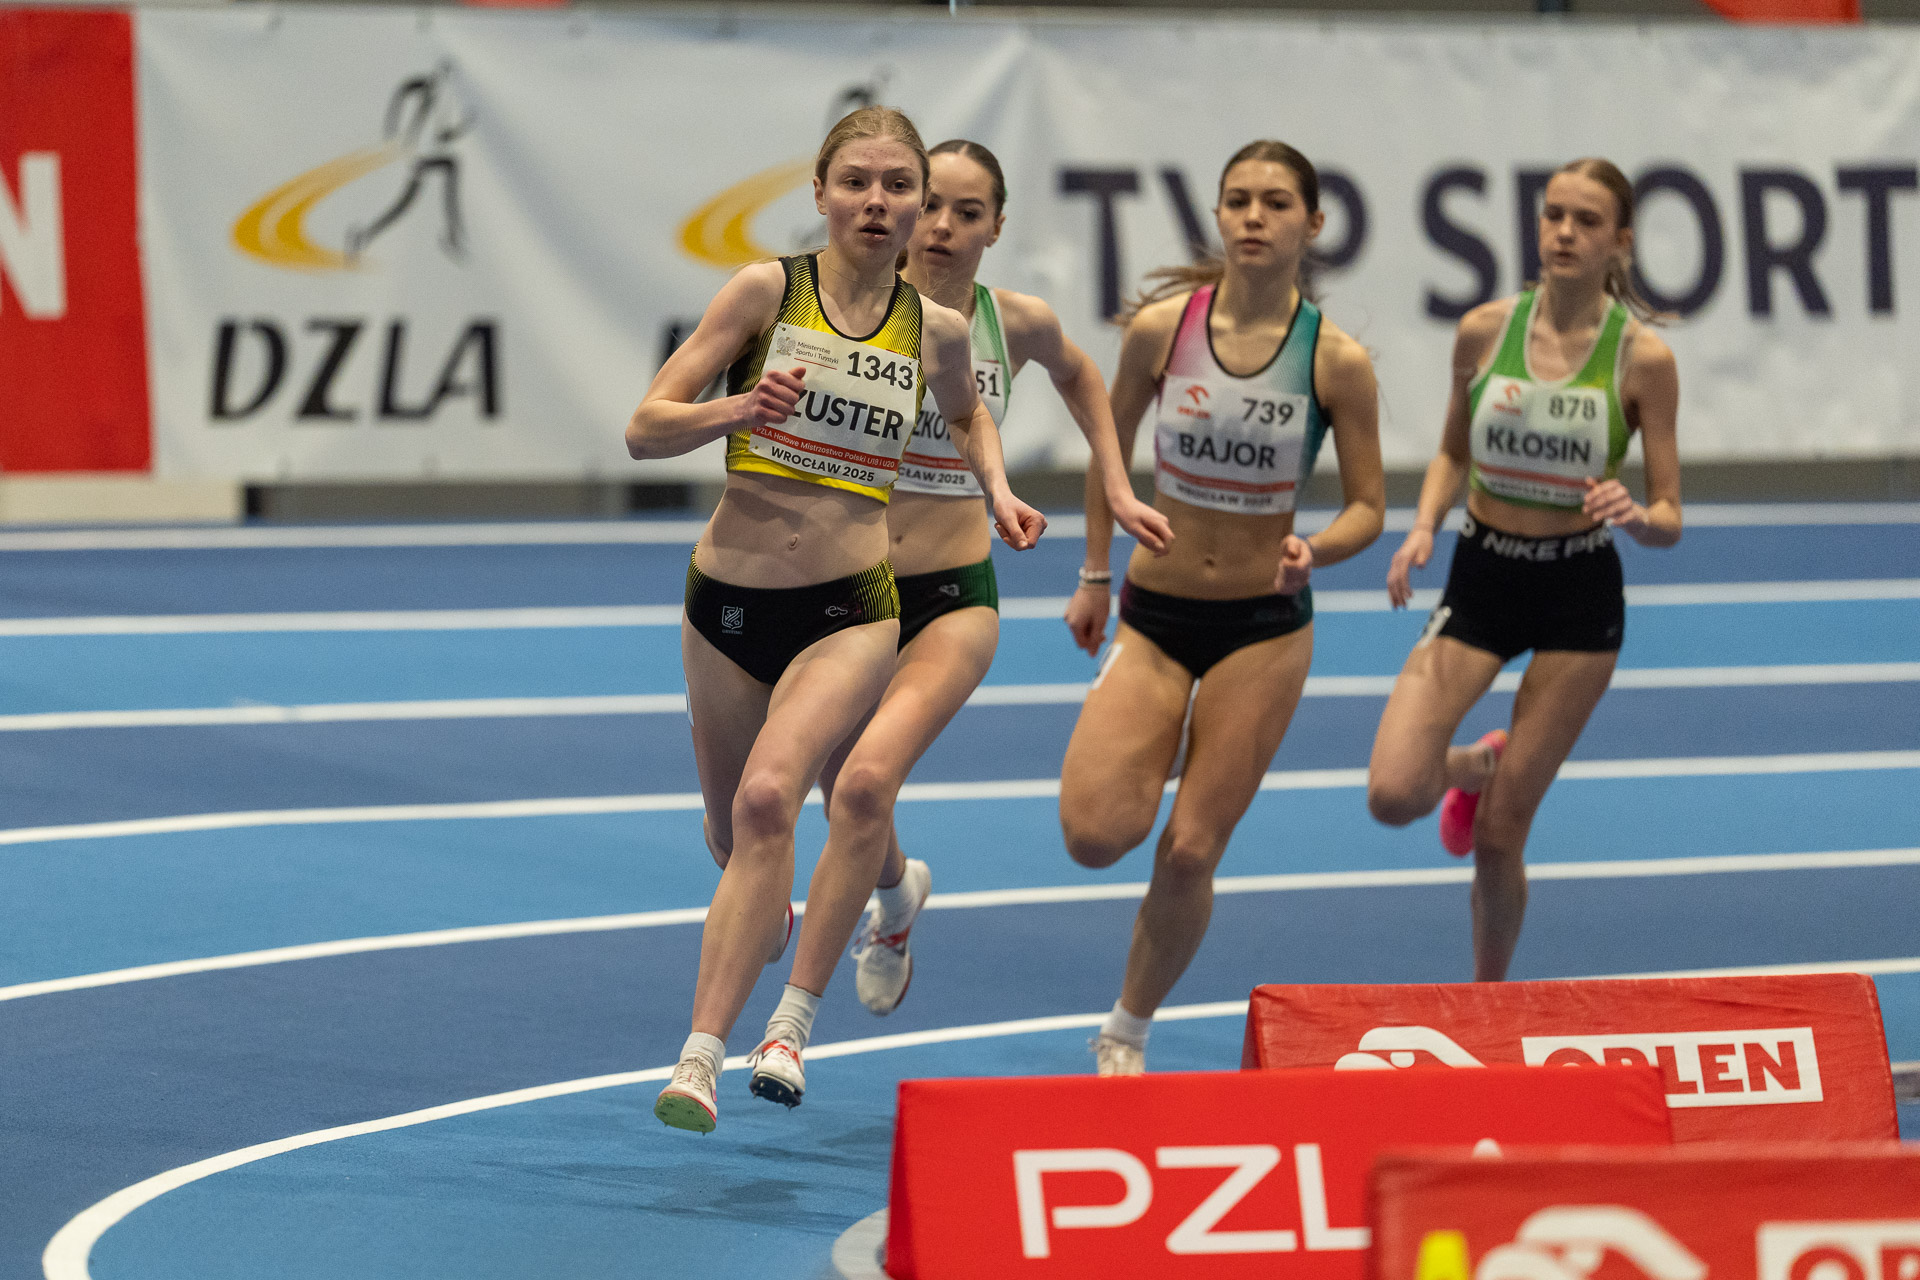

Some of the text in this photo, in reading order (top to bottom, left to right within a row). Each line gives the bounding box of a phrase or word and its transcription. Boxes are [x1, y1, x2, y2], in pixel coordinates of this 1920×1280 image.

[209, 317, 503, 421] DZLA
[795, 348, 814, 357] Sportu
[818, 353, 839, 364] Turystyki
[847, 351, 913, 390] 1343
[1242, 397, 1294, 426] 739
[1549, 395, 1596, 421] 878
[912, 410, 951, 441] ZKO
[755, 427, 772, 437] PZLA
[774, 431, 799, 447] Halowe
[800, 441, 843, 457] Mistrzostwa
[844, 452, 866, 462] Polski
[867, 457, 879, 465] U18
[883, 460, 895, 468] U20
[1179, 433, 1276, 469] BAJOR
[1486, 424, 1592, 464] KŁOSIN
[771, 446, 875, 481] WROCŁAW 2025
[938, 473, 966, 485] 2025
[1482, 532, 1560, 561] NIKE
